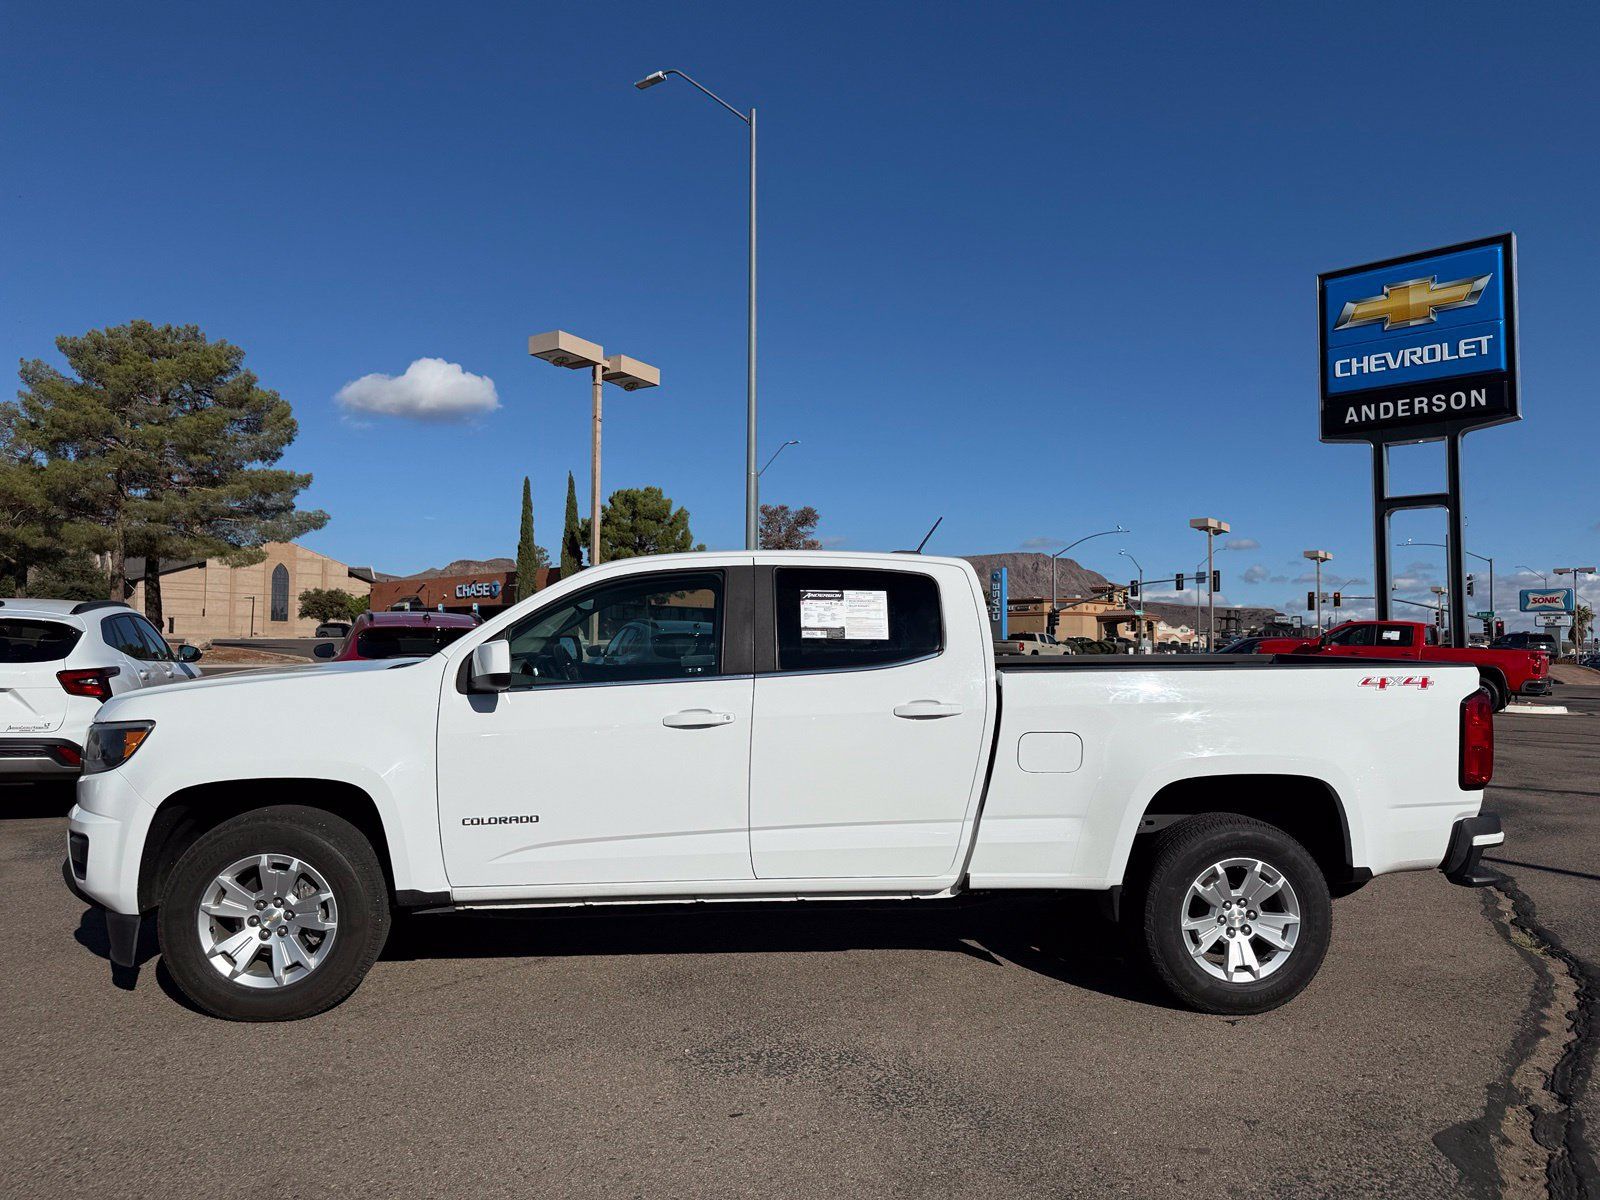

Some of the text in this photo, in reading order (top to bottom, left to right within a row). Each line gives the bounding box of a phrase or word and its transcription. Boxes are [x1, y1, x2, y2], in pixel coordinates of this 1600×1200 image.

[1335, 334, 1494, 378] CHEVROLET
[1345, 388, 1487, 424] ANDERSON
[455, 582, 490, 597] CHASE
[992, 582, 1001, 621] CHASE
[1531, 596, 1560, 604] SONIC
[462, 815, 540, 826] COLORADO
